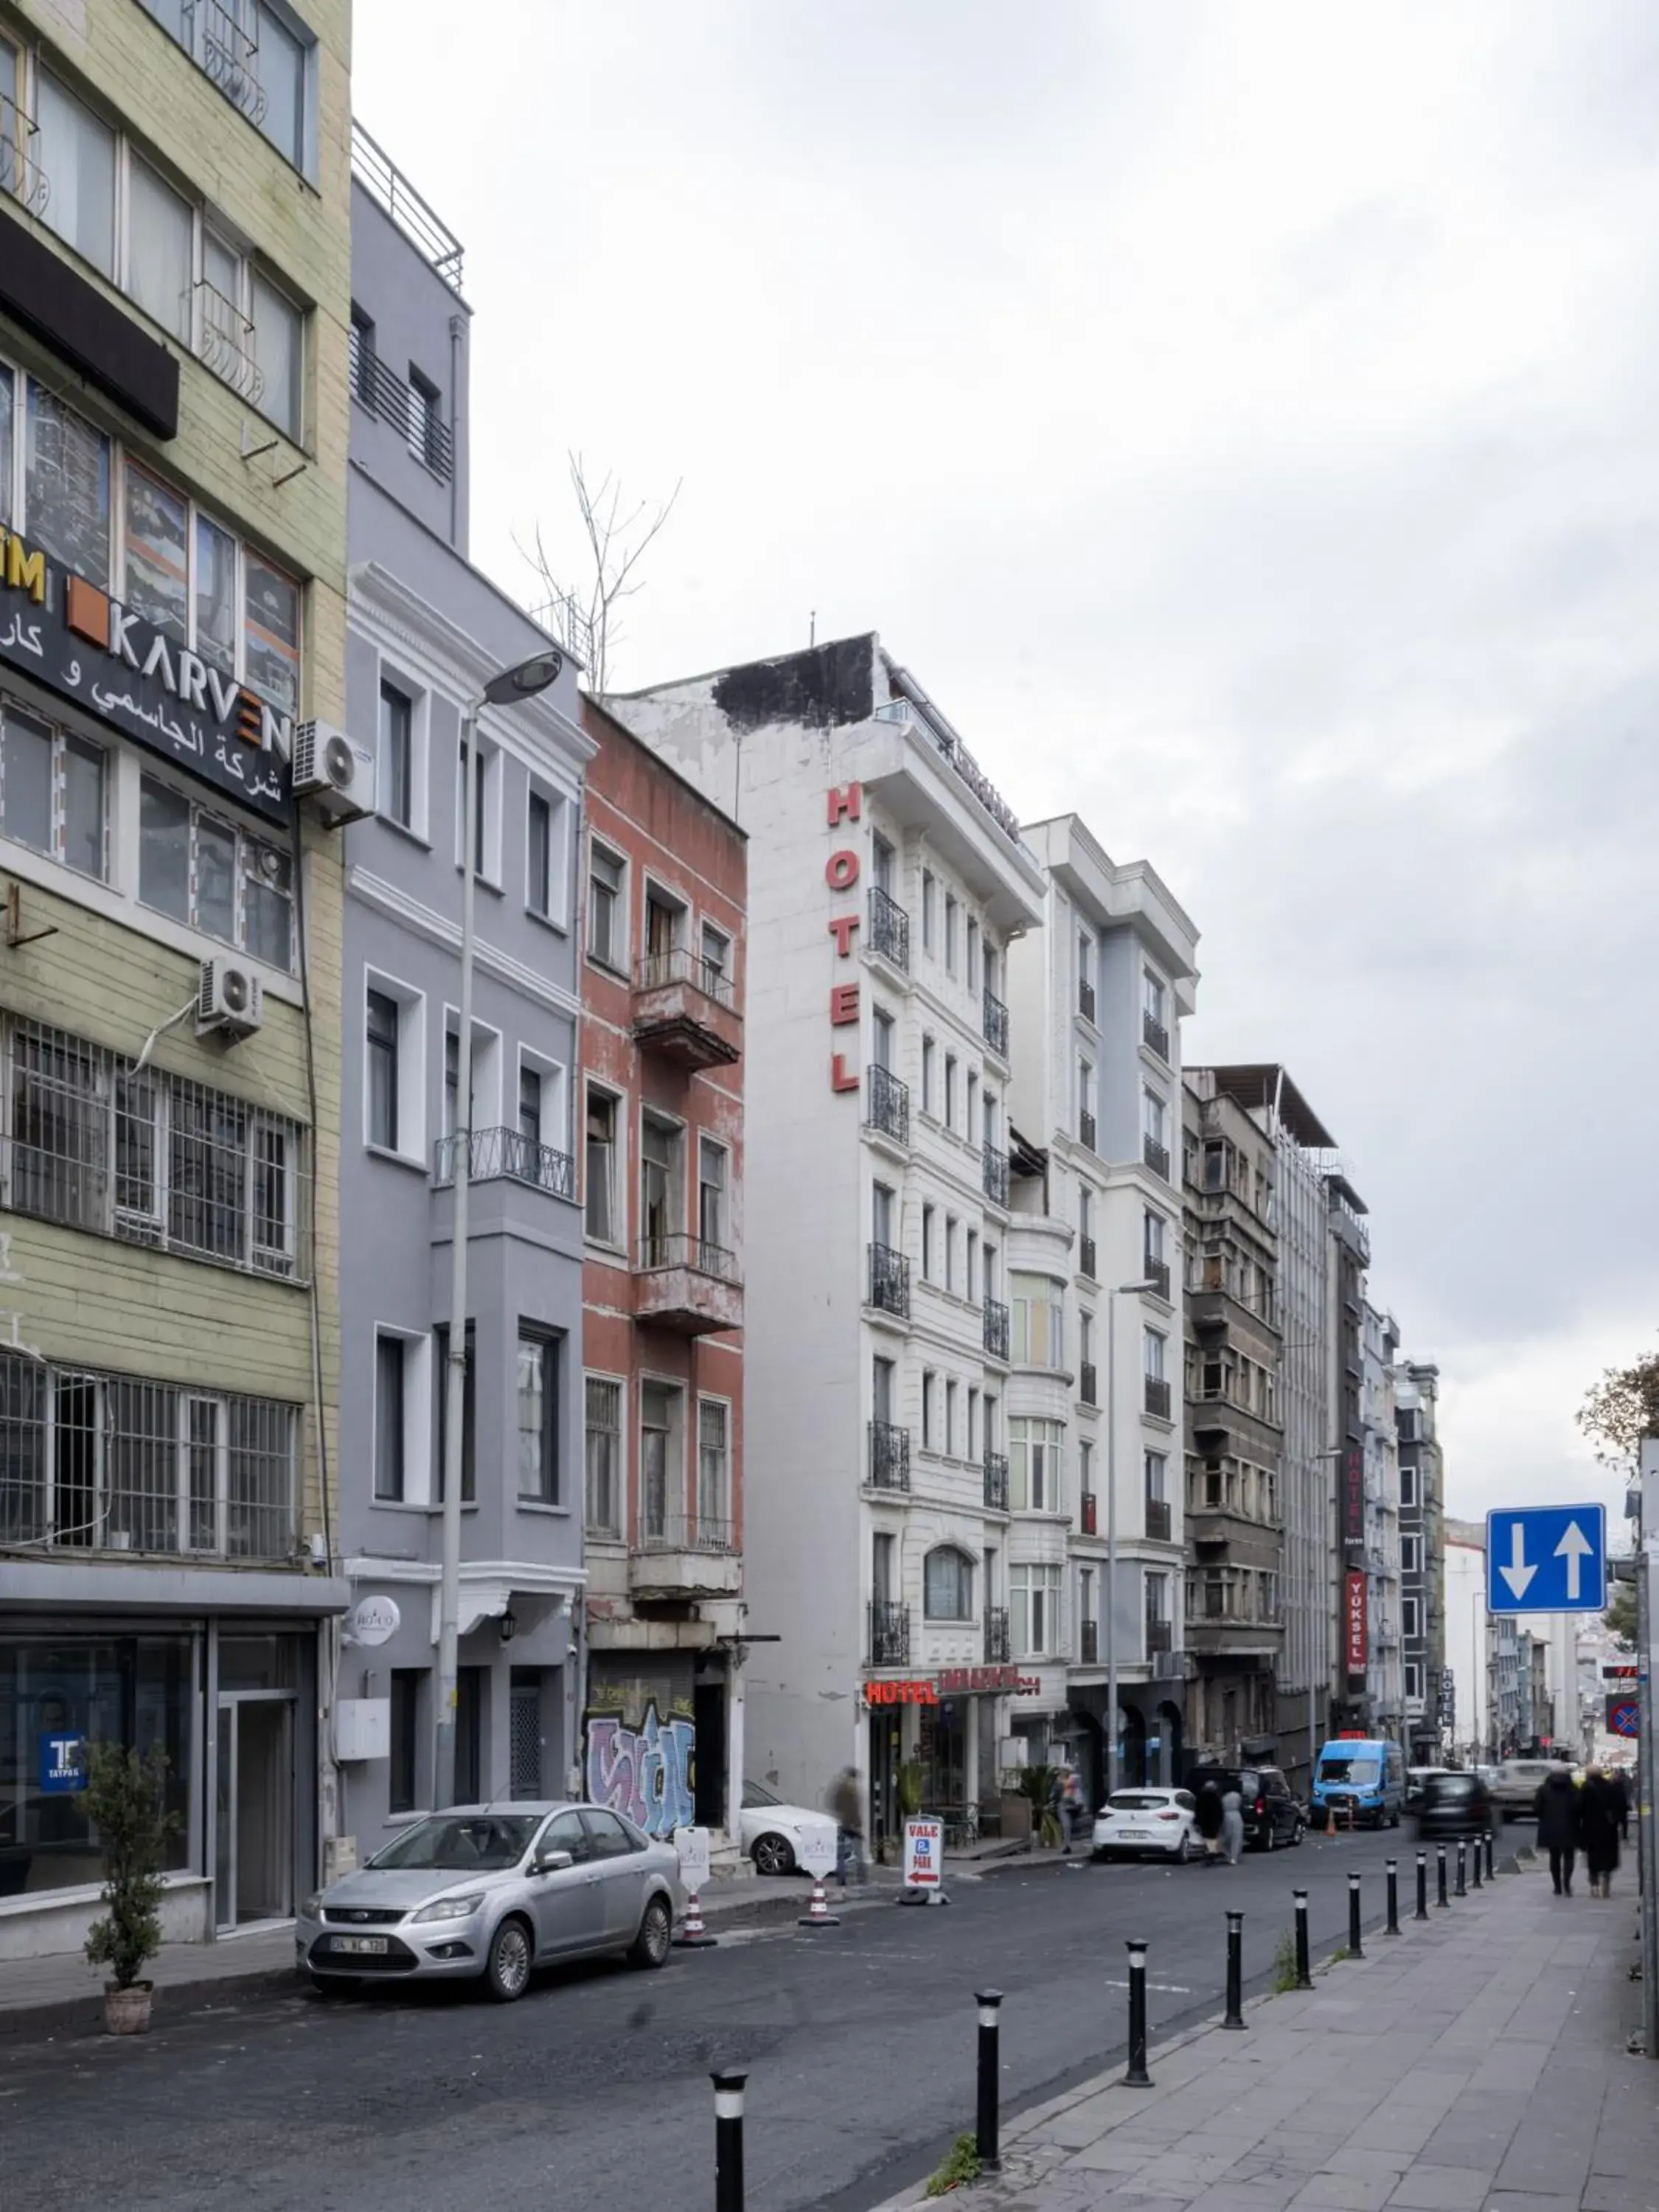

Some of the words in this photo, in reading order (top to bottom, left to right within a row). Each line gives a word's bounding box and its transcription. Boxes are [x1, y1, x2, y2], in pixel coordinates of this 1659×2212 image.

[60, 660, 82, 686] و
[215, 734, 281, 802] شركة
[825, 780, 860, 1092] HOTEL
[866, 1680, 940, 1705] HOTEL
[1442, 1668, 1453, 1722] HOTEL
[909, 1824, 939, 1838] VALE
